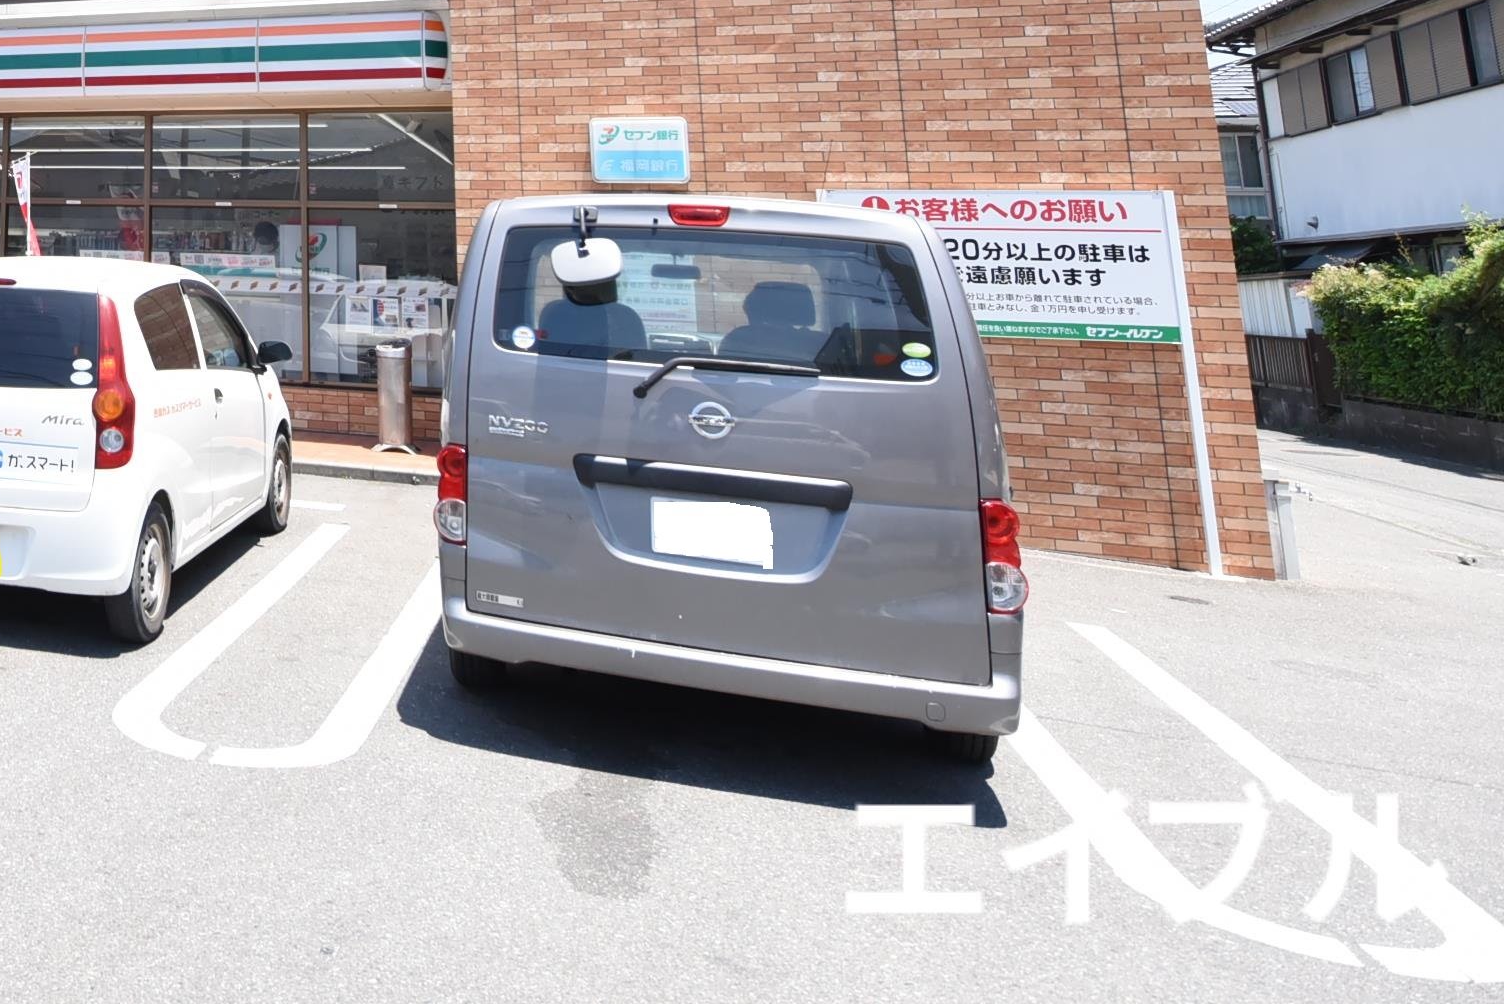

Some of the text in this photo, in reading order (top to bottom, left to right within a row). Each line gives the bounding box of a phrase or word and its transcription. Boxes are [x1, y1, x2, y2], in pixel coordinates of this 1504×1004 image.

[624, 130, 680, 141] セブン銀行
[894, 198, 1128, 223] お客様へのお願い
